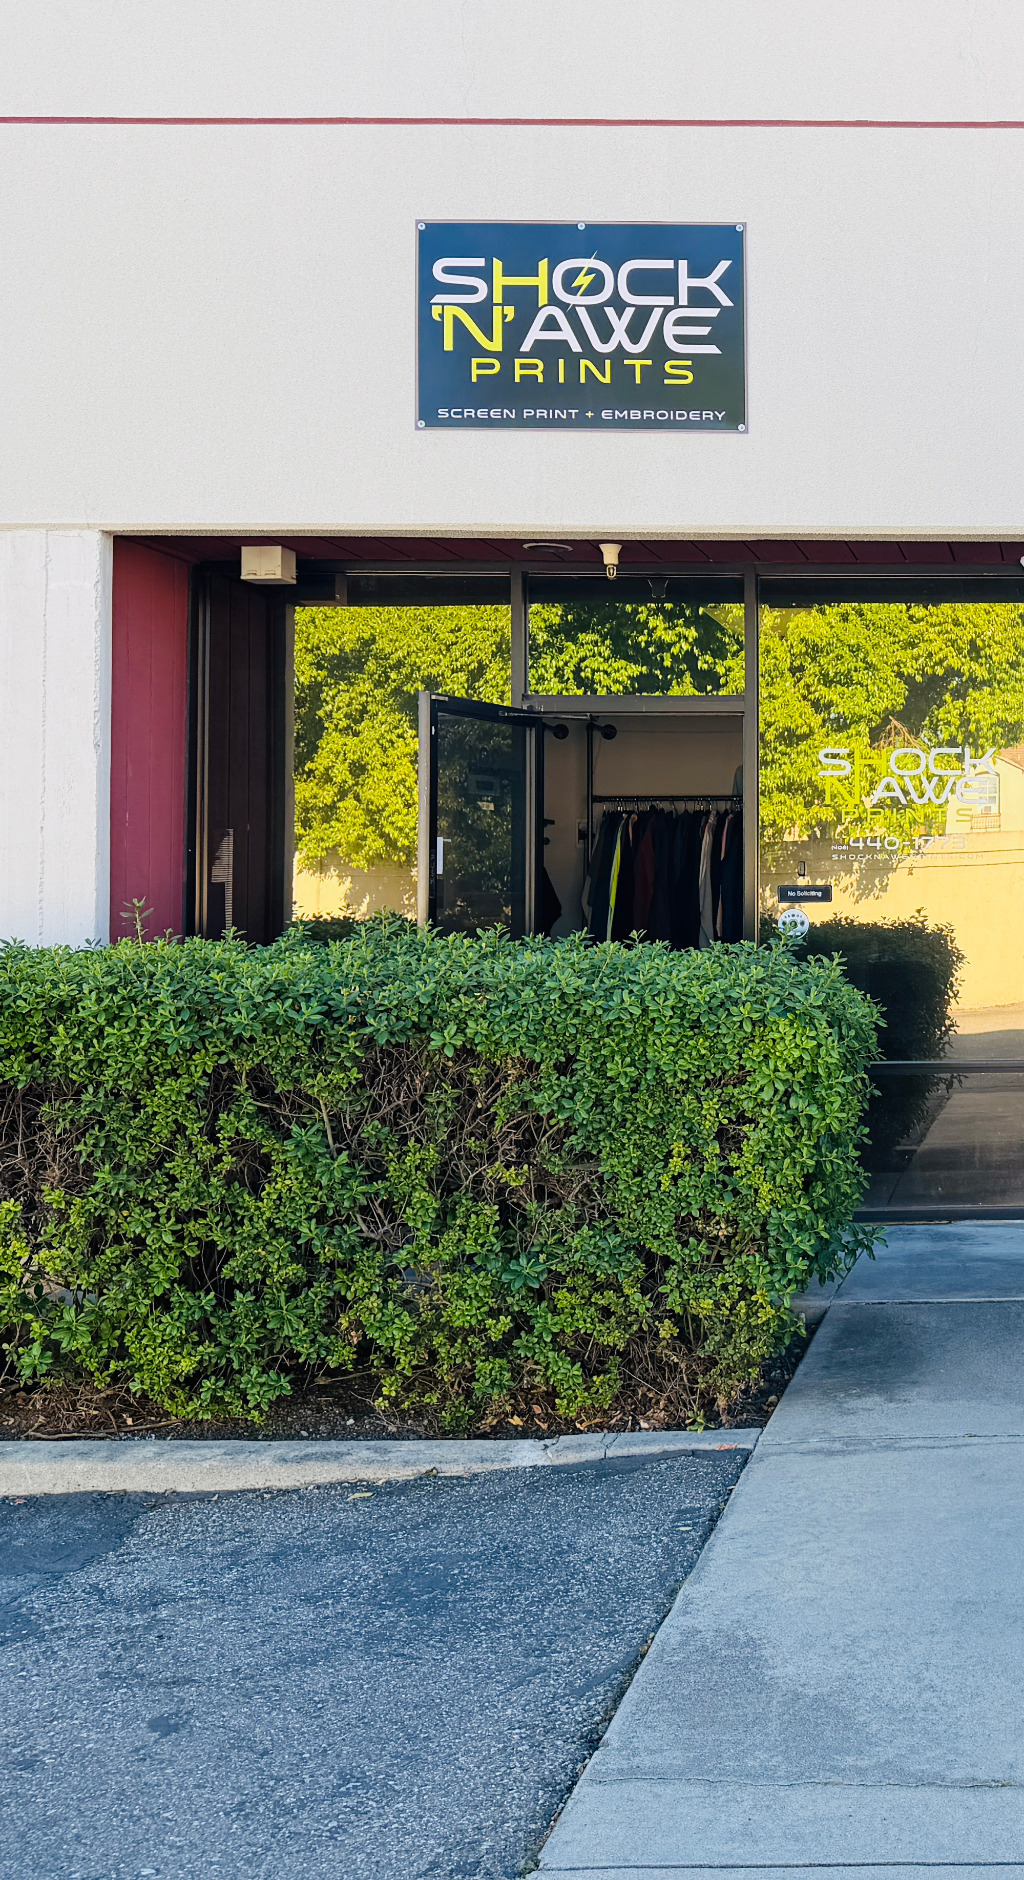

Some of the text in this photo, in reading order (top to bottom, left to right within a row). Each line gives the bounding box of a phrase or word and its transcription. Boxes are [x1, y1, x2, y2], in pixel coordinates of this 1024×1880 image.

[429, 256, 735, 307] SHOCK
[519, 305, 723, 354] AWE
[470, 357, 694, 385] PRINTS
[437, 408, 516, 419] SCREEN
[523, 409, 579, 420] PRINT
[601, 410, 726, 421] EMBROIDERY
[818, 747, 999, 776] SHOCK
[871, 776, 990, 805] AWE
[841, 807, 973, 823] PRINTS
[849, 836, 966, 851] 440-1773
[796, 890, 822, 898] Soliciting
